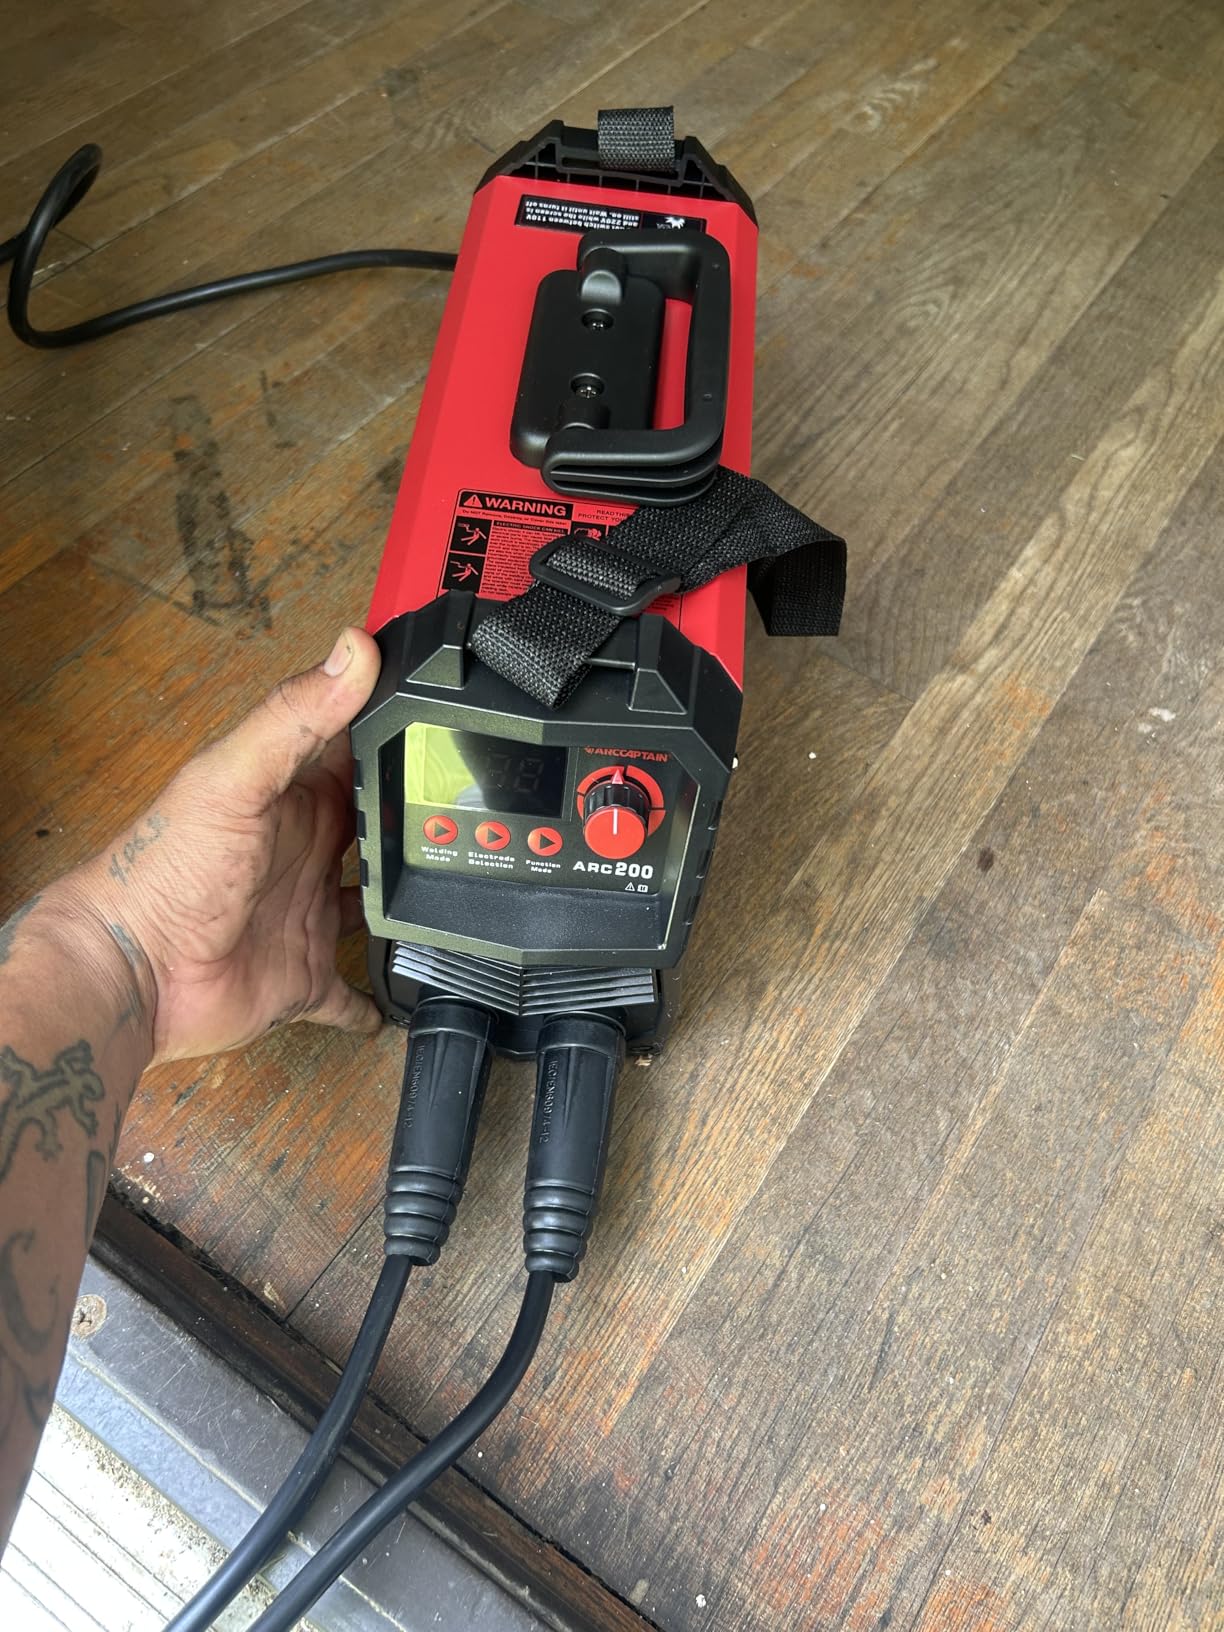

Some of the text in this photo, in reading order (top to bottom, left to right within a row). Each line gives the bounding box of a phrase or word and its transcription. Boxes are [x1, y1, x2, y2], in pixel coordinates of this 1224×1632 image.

[539, 202, 559, 210] turns
[569, 206, 588, 214] until
[535, 209, 562, 217] screen
[589, 209, 607, 217] Wait
[526, 214, 547, 222] 110V
[548, 217, 583, 227] between
[578, 214, 600, 222] while
[600, 217, 622, 226] 220V
[583, 221, 611, 230] switch
[485, 497, 567, 517] WARNING
[578, 513, 608, 521] PROTECT
[594, 746, 669, 762] ARCCAPTAIN
[421, 846, 458, 857] Welding
[426, 854, 451, 862] Mode
[468, 851, 515, 862] Electrode
[468, 858, 514, 869] Selection
[525, 859, 561, 869] Function
[530, 866, 552, 874] Mode
